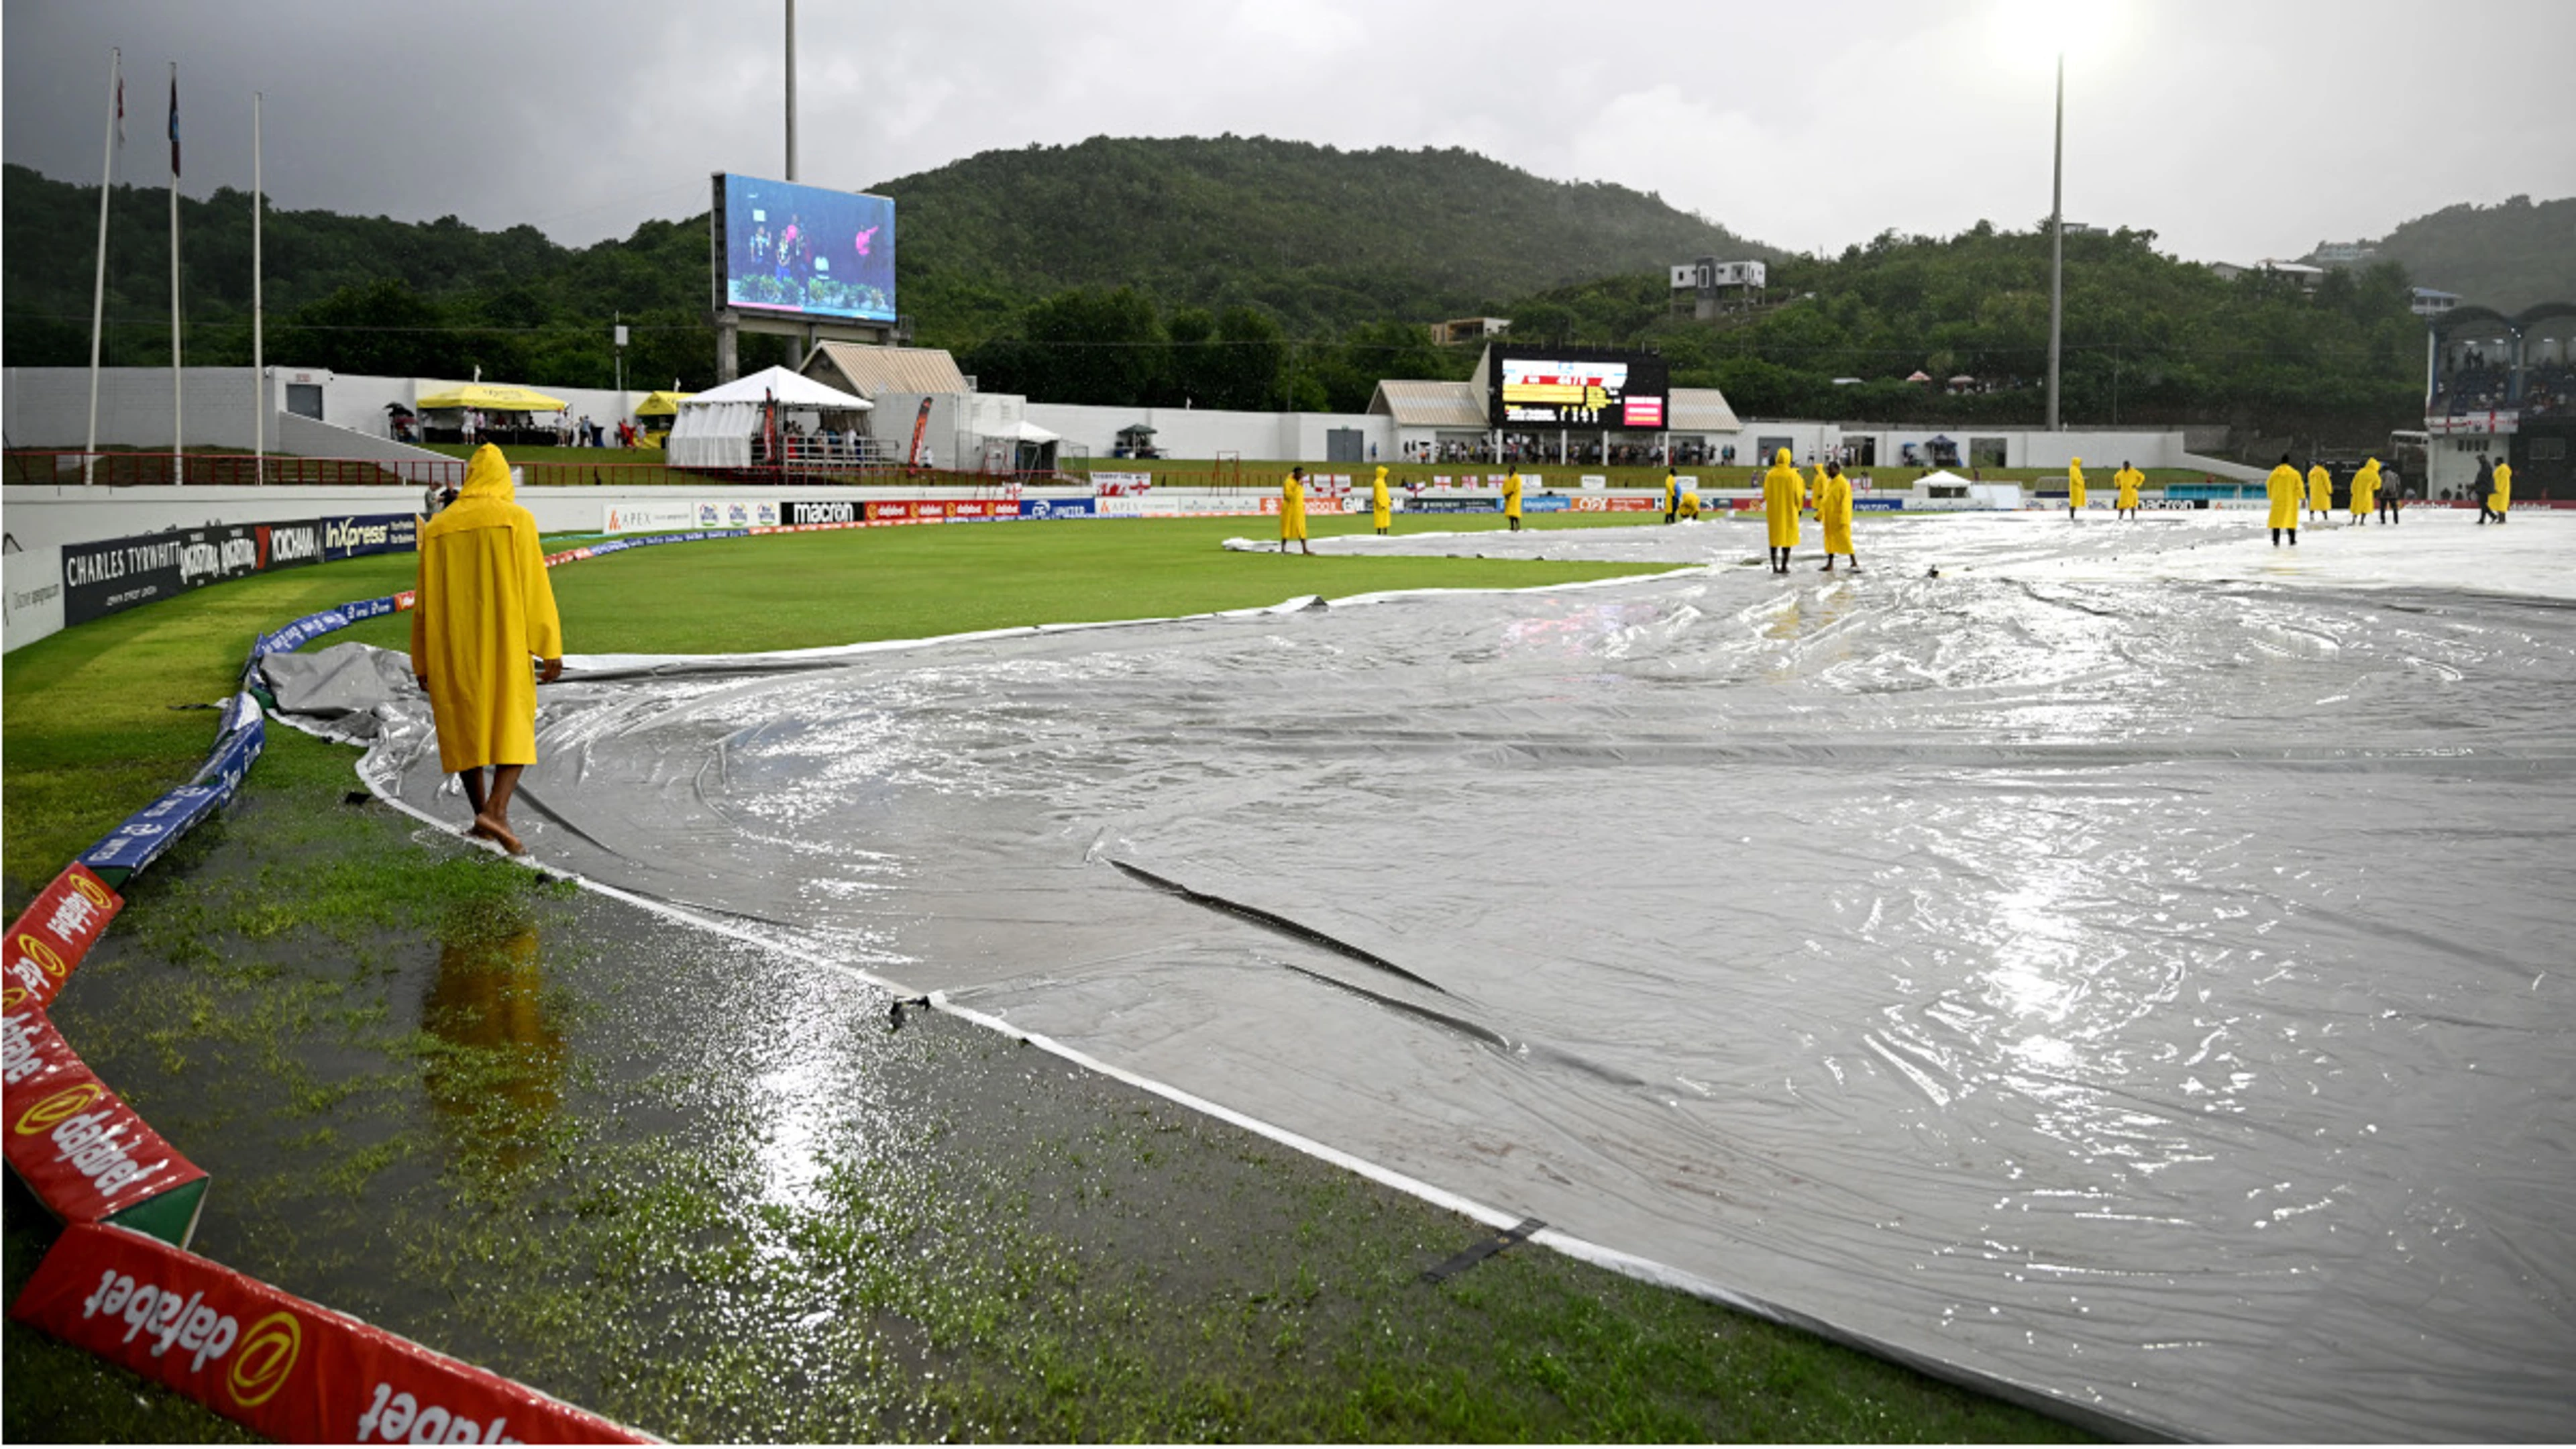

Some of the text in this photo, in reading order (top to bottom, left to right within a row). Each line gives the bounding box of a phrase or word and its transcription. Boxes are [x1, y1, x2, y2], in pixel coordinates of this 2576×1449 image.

[623, 512, 651, 526] APEX
[794, 504, 854, 523] macron
[326, 517, 388, 556] InXpress
[68, 549, 124, 586] CHARLES
[52, 1110, 169, 1197] dafabet
[83, 1270, 238, 1373] dafabet
